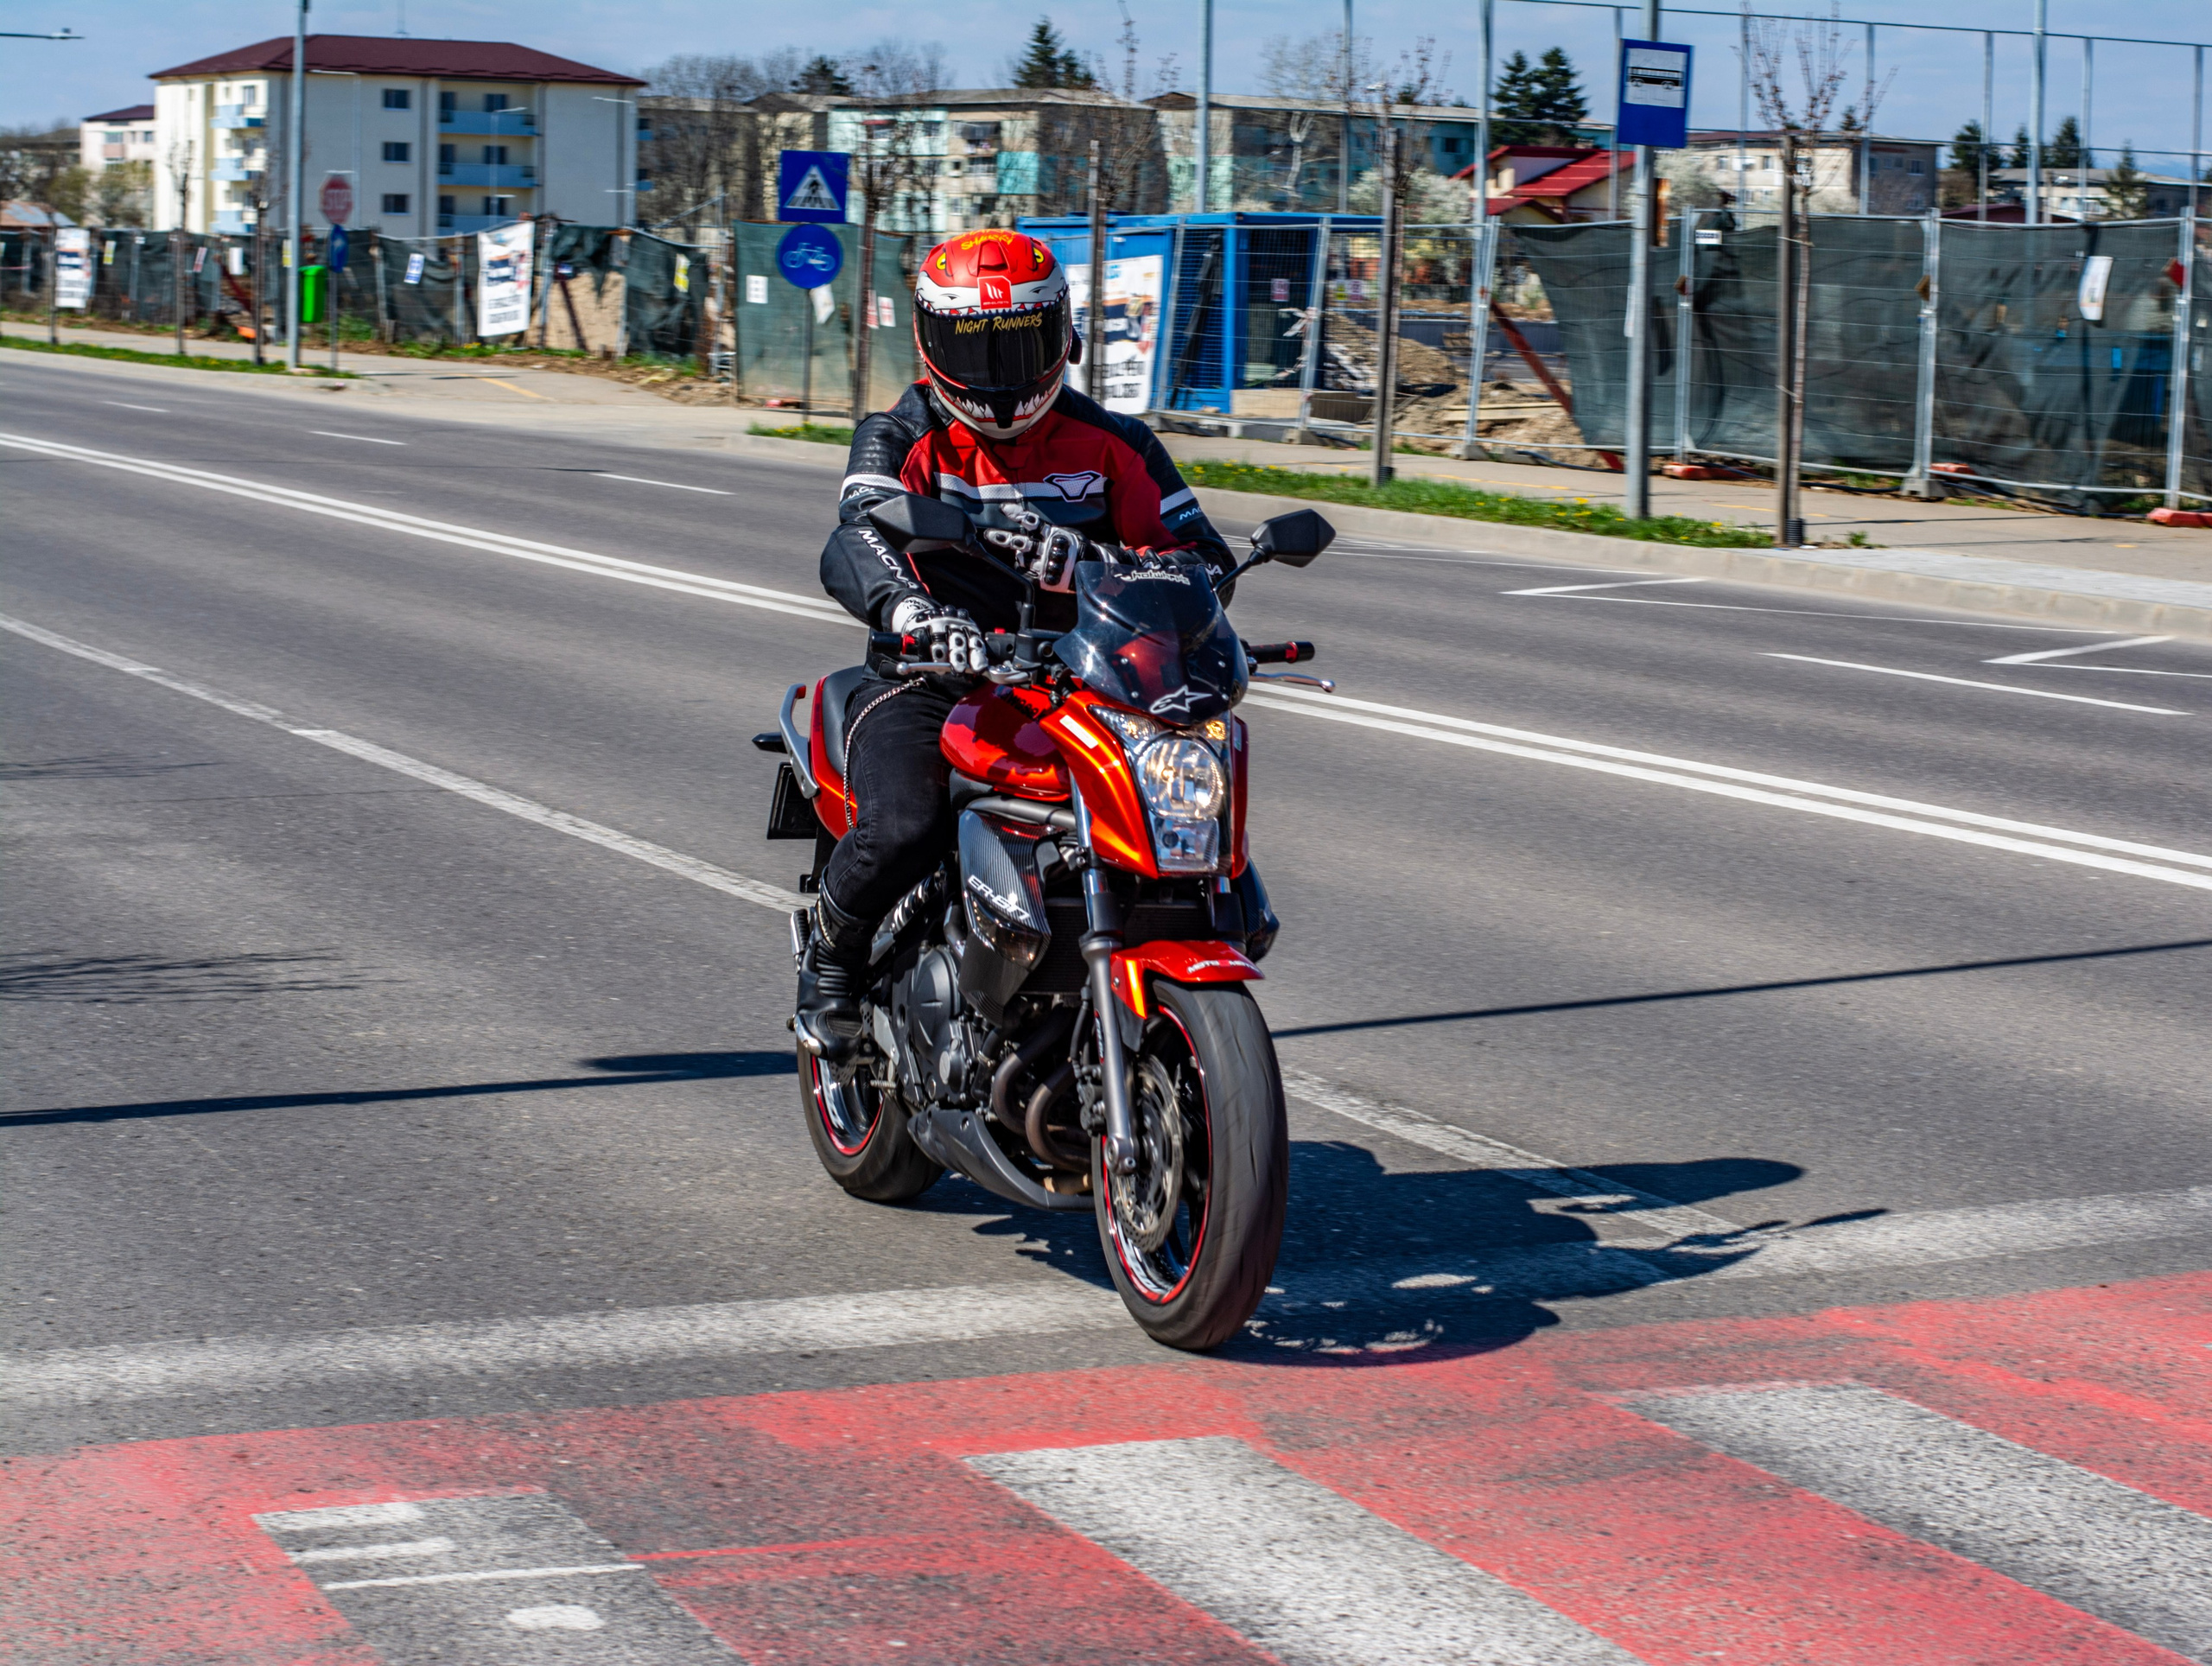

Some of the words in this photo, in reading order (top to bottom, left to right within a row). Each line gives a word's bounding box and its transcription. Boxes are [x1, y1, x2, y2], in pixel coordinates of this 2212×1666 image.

[955, 318, 988, 334] NIGHT
[992, 312, 1043, 332] RUNNERS
[858, 530, 919, 589] MACNA
